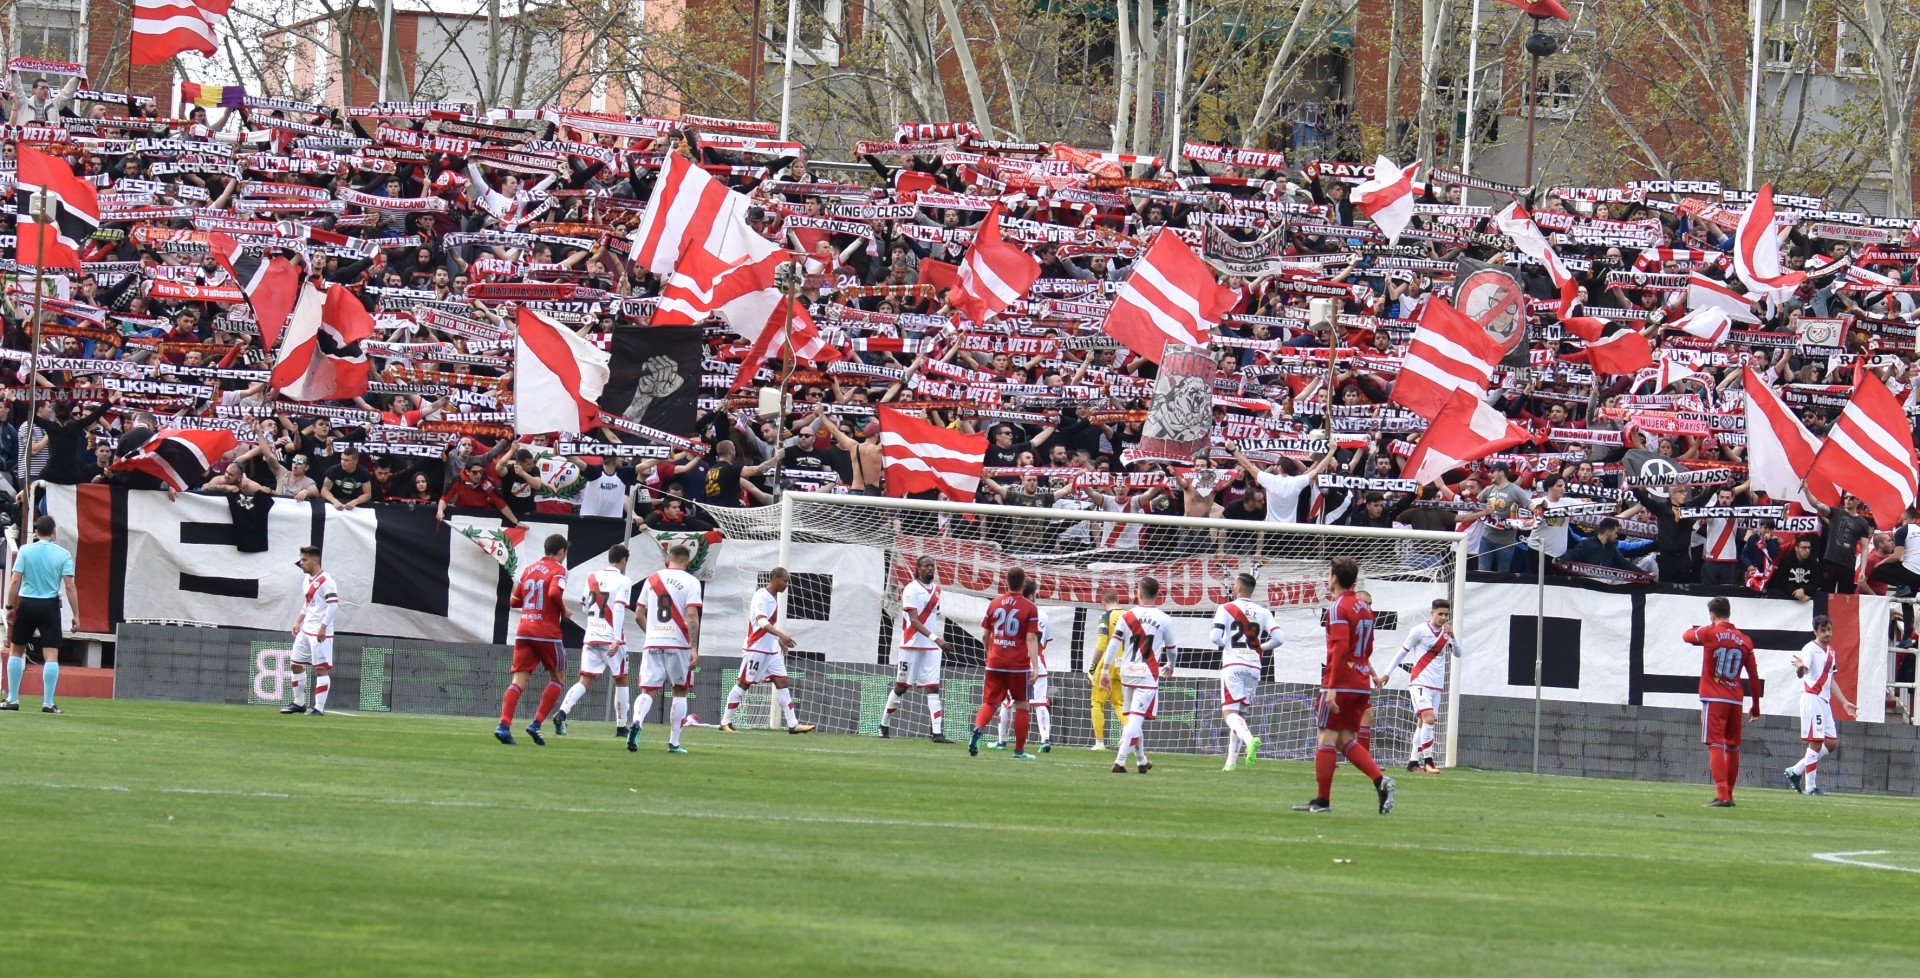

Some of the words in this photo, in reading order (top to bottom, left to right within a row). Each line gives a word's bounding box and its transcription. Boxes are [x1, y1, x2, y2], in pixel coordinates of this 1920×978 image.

[23, 128, 51, 141] VETE
[52, 129, 66, 141] YA
[379, 129, 415, 146] PRESA
[435, 138, 467, 153] VETE
[136, 138, 232, 157] BUKANEROS
[527, 140, 603, 158] BUKANEROS
[1002, 142, 1039, 150] Vallecano
[508, 153, 557, 168] VALLECANO
[1184, 144, 1218, 160] PRESA
[1238, 151, 1267, 166] VETE
[1268, 154, 1283, 166] YA
[356, 195, 377, 206] RAYO
[380, 197, 426, 209] VALLECANO
[1724, 190, 1822, 209] BUKNEROS
[877, 206, 914, 216] CLASS
[791, 217, 871, 236] BUKANEROS
[1535, 213, 1571, 229] PRESA
[1822, 226, 1841, 235] RAYO
[1843, 227, 1883, 237] VALLECANO
[476, 259, 510, 274] PRESA
[158, 285, 180, 296] Rayo
[1307, 284, 1346, 295] Vallecano
[433, 316, 453, 329] RAYO
[454, 321, 500, 340] VALLECANO
[1857, 320, 1878, 332] Rayo
[1008, 338, 1038, 352] VETE
[37, 360, 122, 372] BUKANEROS
[928, 361, 962, 375] PRESA
[161, 364, 269, 383] BUKANEROS
[10, 388, 51, 401] PRSA
[103, 378, 214, 398] BUKANEROS
[966, 388, 997, 403] VETE
[1786, 392, 1807, 403] Rayo
[1228, 424, 1256, 438] VETE
[1640, 418, 1664, 428] MUJER
[1677, 421, 1709, 431] RAYISTA
[391, 432, 457, 441] PRIMERA
[333, 443, 444, 457] BUKANEROS
[561, 445, 674, 461] BUKANEROS
[1129, 473, 1158, 486] VETE
[1319, 474, 1418, 491] BUKANEROS
[1691, 469, 1729, 483] CLASS
[1057, 303, 1078, 313] RAYO
[1417, 686, 1423, 697] 7
[1681, 504, 1783, 518] BUKANEROS
[1776, 517, 1815, 531] CLASS
[666, 577, 684, 591] TREJO
[524, 579, 545, 610] 21
[588, 591, 610, 618] 27
[657, 594, 672, 623] 8
[993, 607, 1020, 636] 26
[1138, 617, 1161, 630] BARBA
[1354, 618, 1374, 657] 17
[1716, 632, 1731, 642] JAVI
[1732, 635, 1744, 647] ROS
[1129, 634, 1155, 663] 11
[749, 659, 760, 671] 14
[899, 661, 909, 671] 15
[1713, 647, 1743, 679] 10
[1815, 714, 1822, 726] 5
